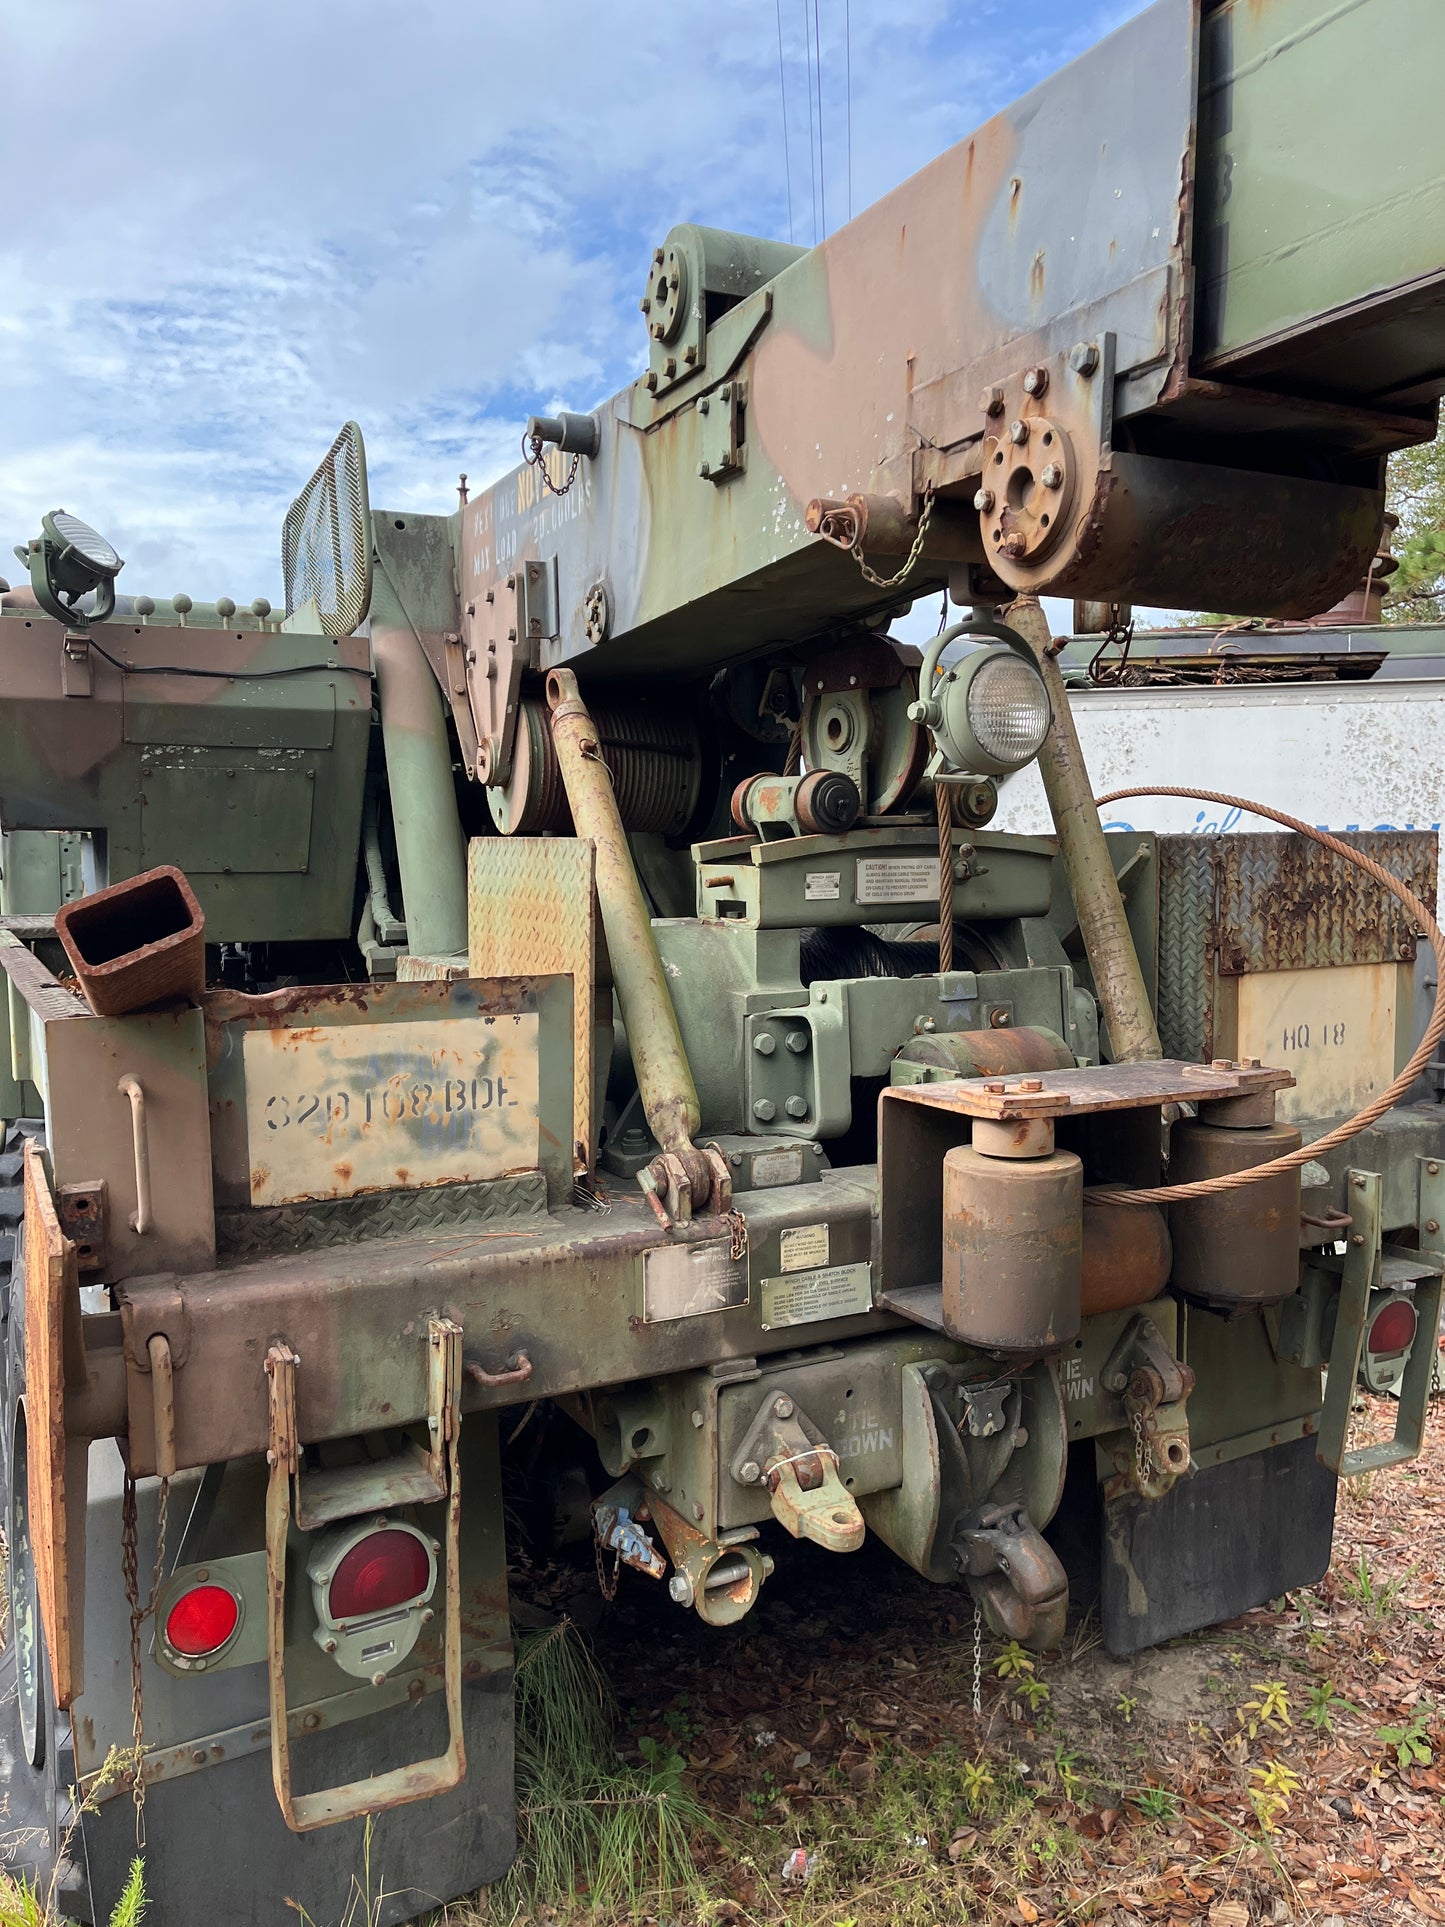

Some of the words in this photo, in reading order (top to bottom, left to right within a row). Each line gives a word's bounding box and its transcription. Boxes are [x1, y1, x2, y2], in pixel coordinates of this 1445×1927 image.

[473, 546, 489, 577] MAX
[496, 529, 517, 565] LOAD
[1283, 1024, 1309, 1051] HQ
[1324, 1022, 1345, 1046] 18
[446, 1076, 518, 1112] BDE
[1063, 1357, 1082, 1380] IE
[850, 1410, 879, 1432] TIE
